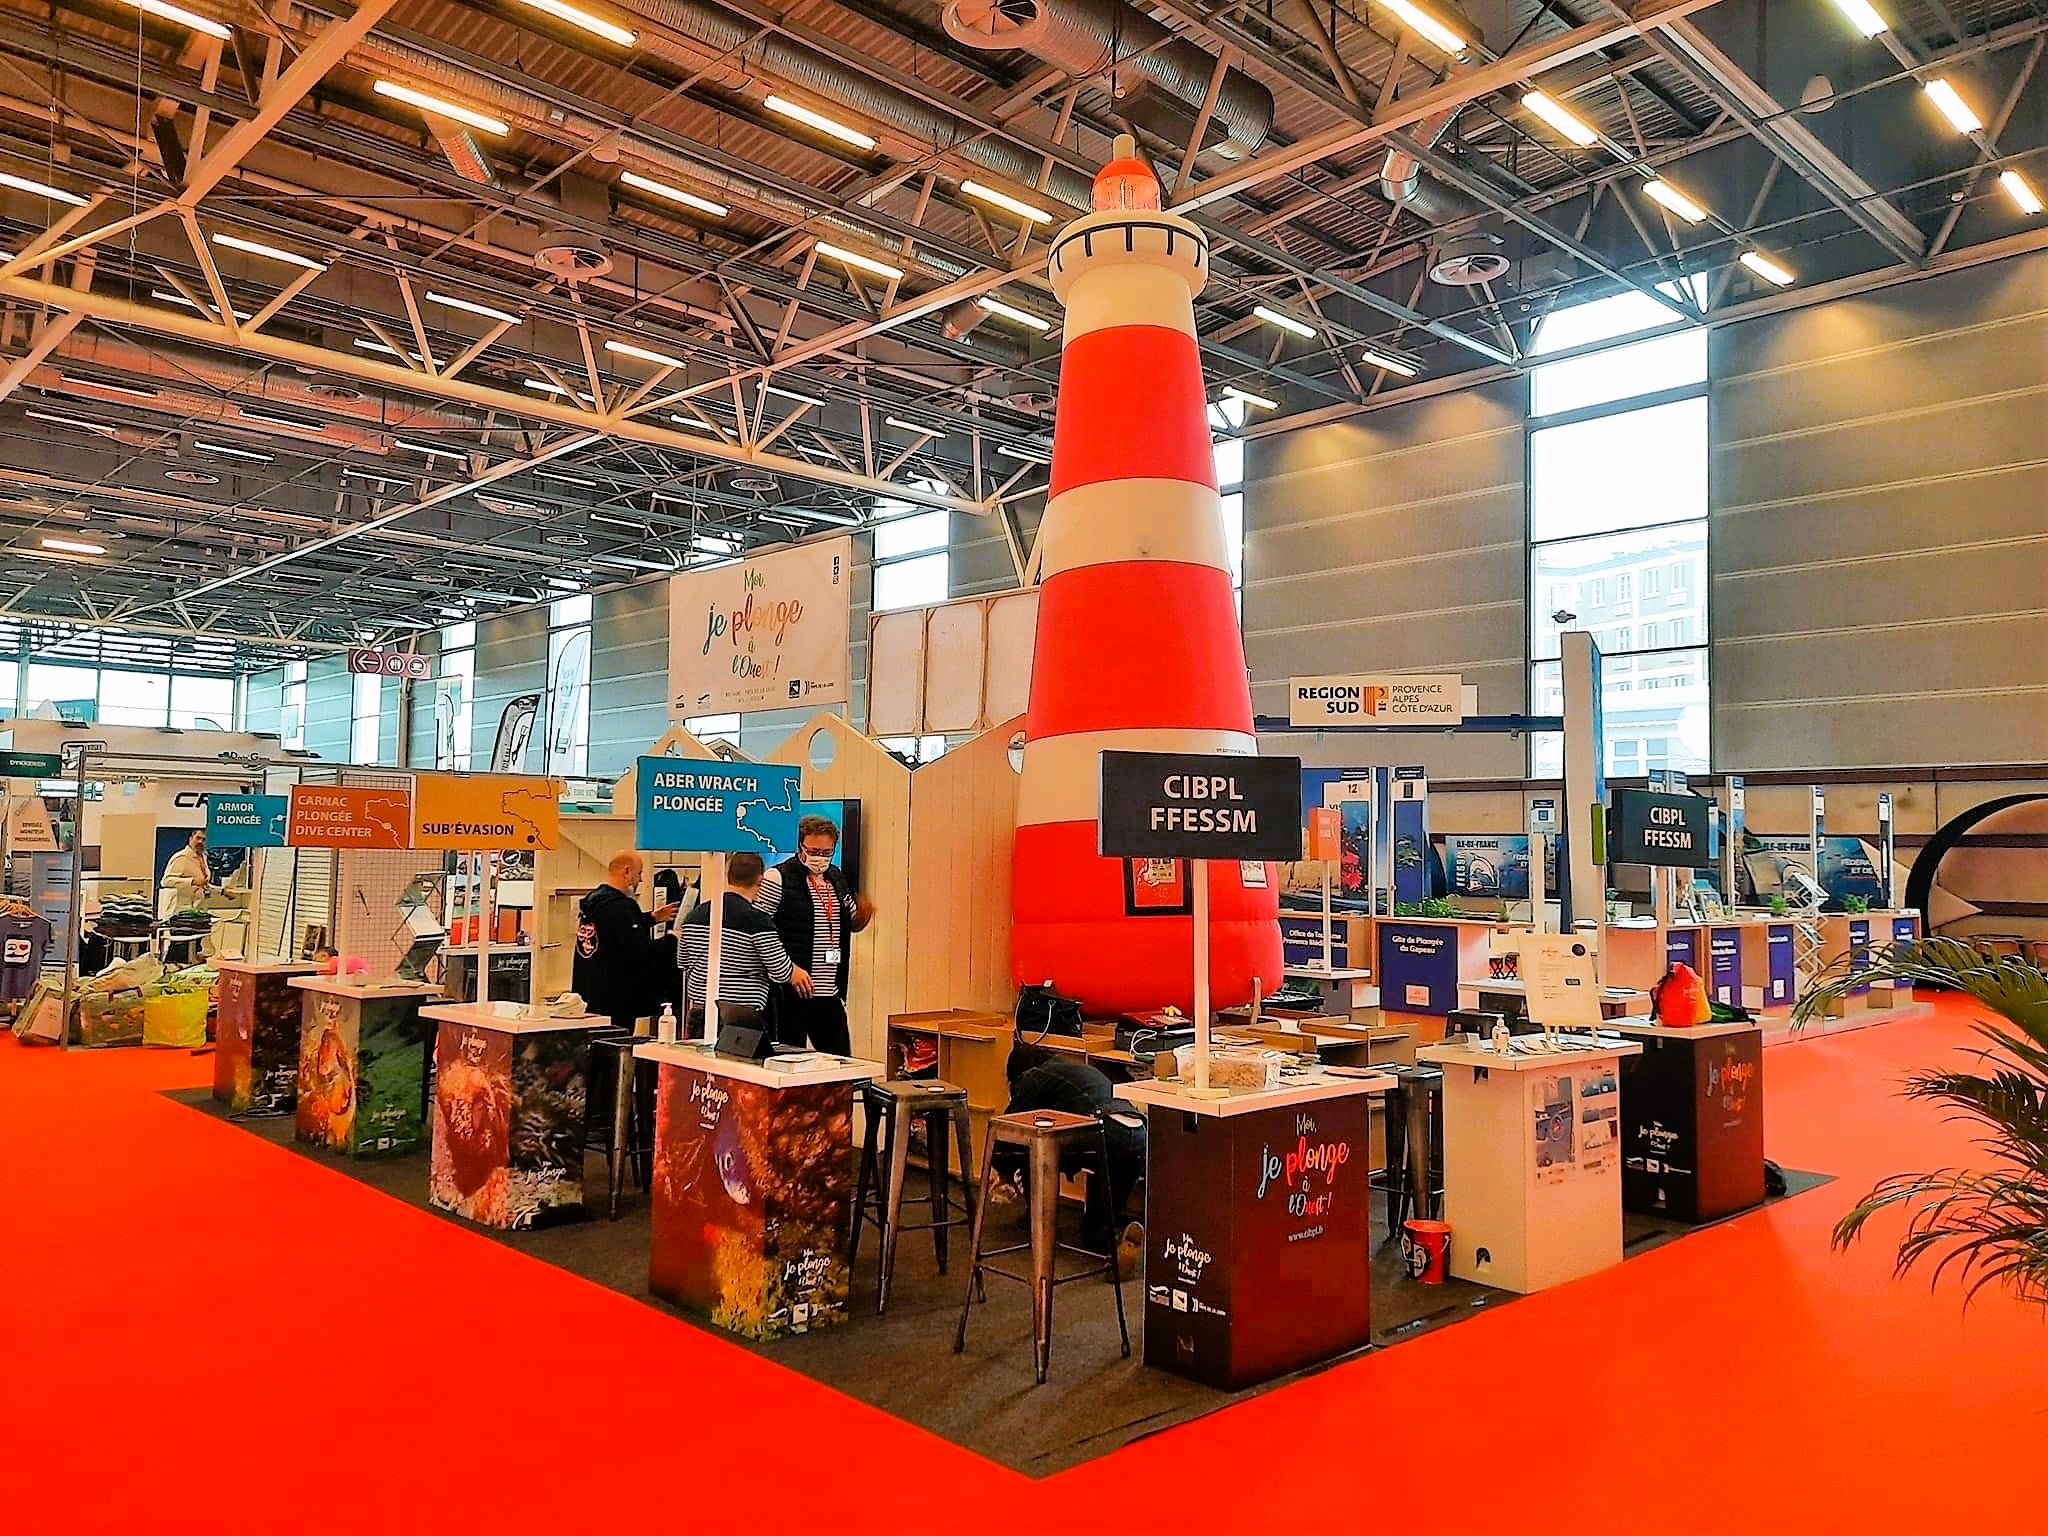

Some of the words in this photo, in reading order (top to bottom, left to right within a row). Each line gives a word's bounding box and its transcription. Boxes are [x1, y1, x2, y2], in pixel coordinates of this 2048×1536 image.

[703, 601, 727, 656] je
[732, 593, 804, 647] plonge
[1298, 686, 1360, 699] REGION
[1392, 685, 1442, 693] PROVENCE
[1392, 694, 1420, 703] ALPES
[1326, 701, 1360, 714] SUD
[1392, 703, 1419, 713] CÔTE
[1419, 704, 1453, 713] D'AZUR
[653, 772, 695, 788] ABER
[698, 775, 758, 792] WRAC'H
[1163, 775, 1244, 801] CIBPL
[217, 802, 254, 812] ARMOR
[297, 795, 348, 807] CARNAC
[653, 795, 723, 812] PLONGÉE
[216, 814, 262, 825] PLONGÉE
[296, 809, 353, 822] PLONGÉE
[1150, 807, 1257, 833] FFESSM
[1650, 807, 1687, 826] CIBPL
[295, 825, 325, 836] DIVE
[326, 826, 372, 838] CENTER
[422, 820, 514, 836] SUB'ÉVASION
[1644, 829, 1692, 849] FFESSM
[1296, 1112, 1317, 1136] Moi,
[1257, 1142, 1282, 1199] je
[1286, 1135, 1350, 1187] plonge
[1302, 1175, 1311, 1193] à
